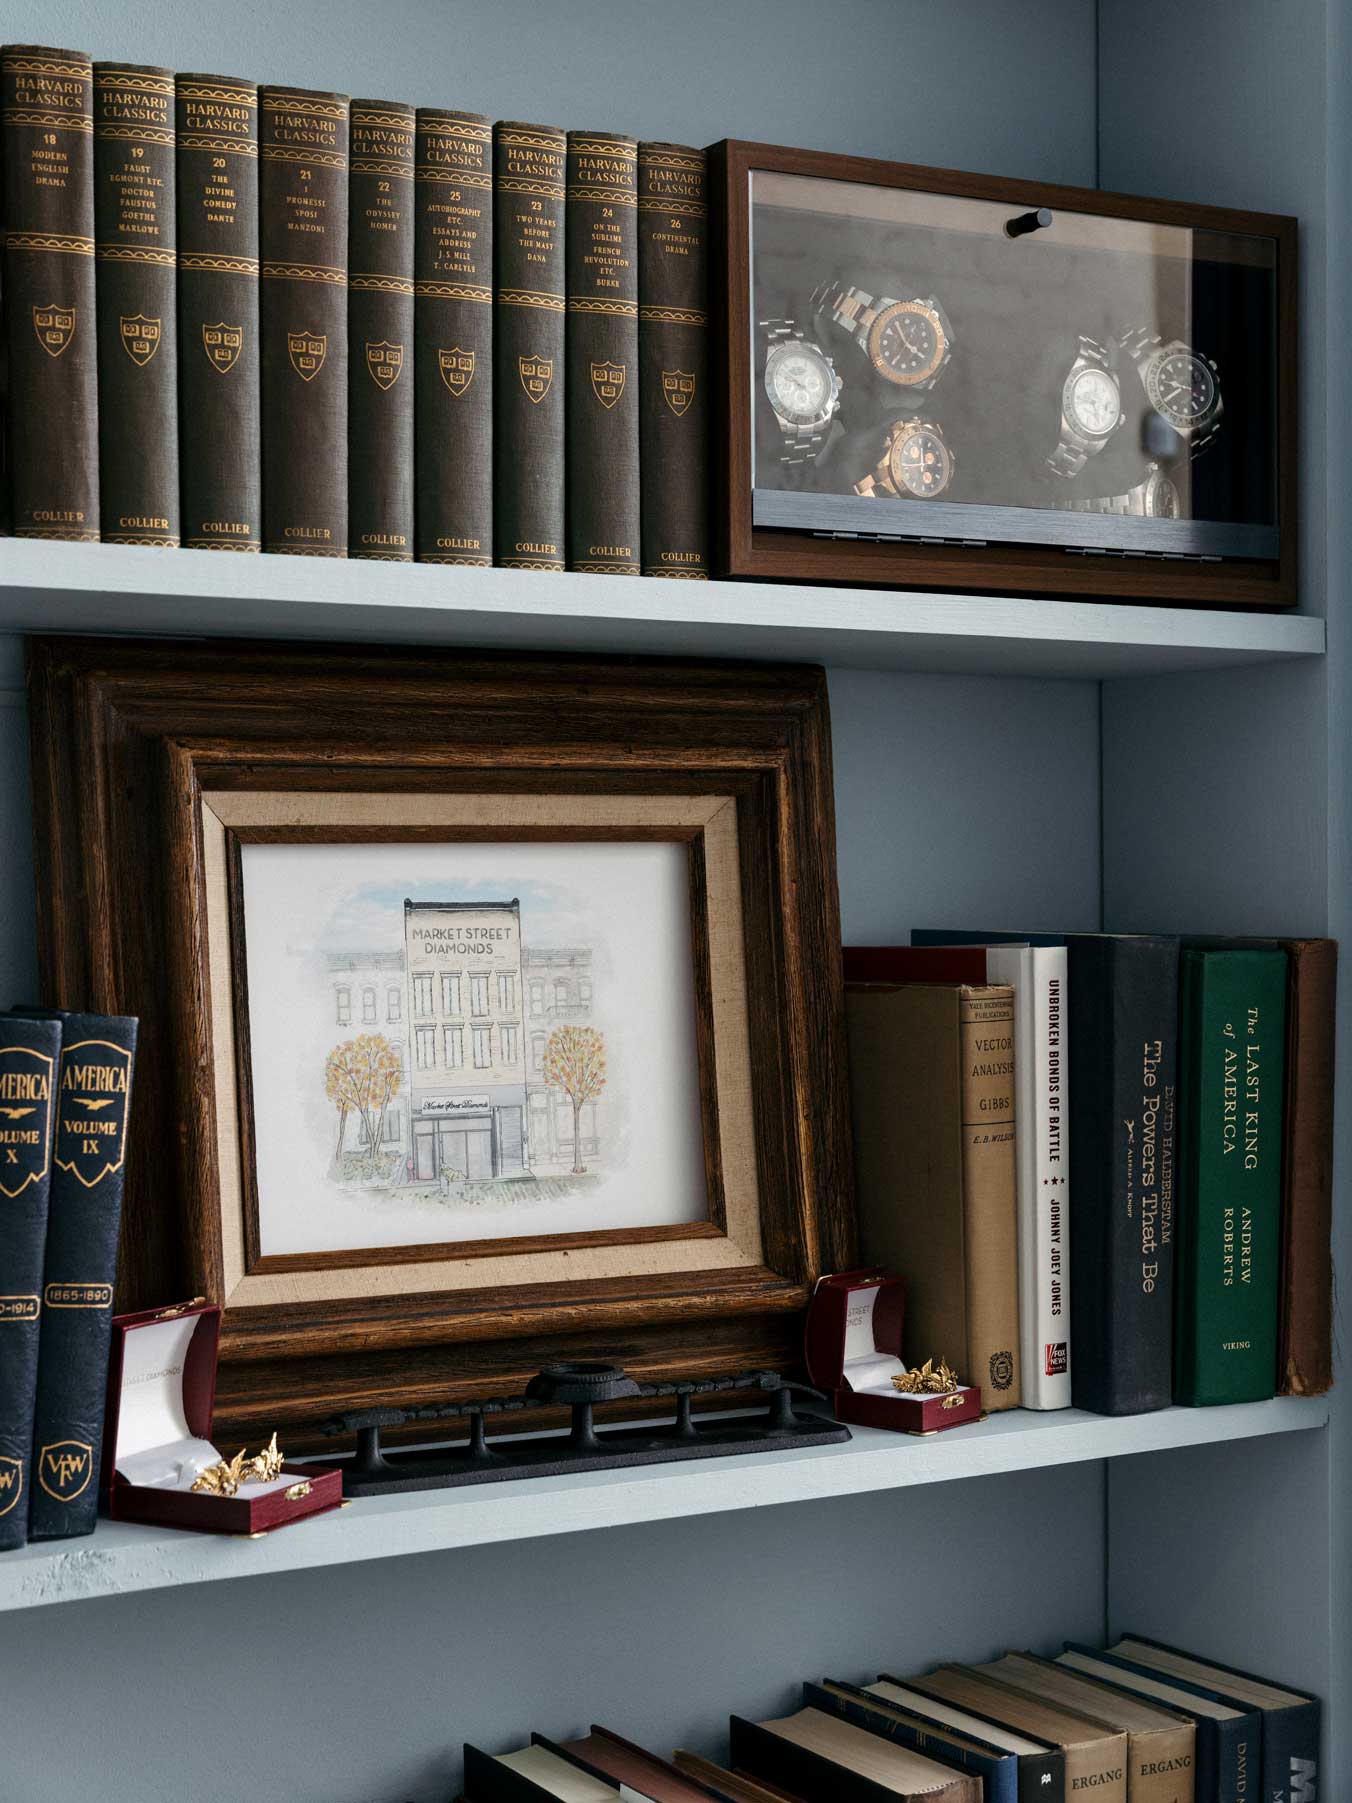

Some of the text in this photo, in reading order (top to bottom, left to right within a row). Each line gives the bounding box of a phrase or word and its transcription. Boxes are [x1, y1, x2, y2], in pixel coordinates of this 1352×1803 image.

[16, 78, 82, 94] HARVARD
[16, 92, 82, 107] CLASSICS
[104, 92, 167, 109] HARVARD
[104, 106, 167, 122] CLASSICS
[186, 104, 248, 120] HARVARD
[186, 117, 248, 133] CLASSICS
[275, 116, 336, 132] HARVARD
[44, 134, 56, 144] 18
[275, 129, 336, 145] CLASSICS
[353, 130, 413, 145] HARVARD
[131, 147, 144, 157] 19
[353, 142, 412, 158] CLASSICS
[428, 137, 482, 155] HARVARD
[32, 150, 67, 160] MODERN
[427, 151, 482, 167] CLASSICS
[508, 149, 563, 165] HARVARD
[32, 163, 68, 174] ENGLISH
[124, 164, 151, 173] FAUST
[212, 158, 226, 168] 20
[580, 158, 633, 172] HARVARD
[300, 170, 311, 180] 21
[508, 162, 563, 178] CLASSICS
[36, 176, 66, 186] DRAMA
[212, 176, 228, 184] THE
[579, 170, 632, 185] CLASSICS
[649, 170, 701, 184] HARVARD
[122, 188, 154, 198] DOCTOR
[206, 187, 235, 197] DIVINE
[378, 182, 390, 192] 22
[649, 182, 703, 196] CLASSICS
[450, 191, 461, 200] 25
[120, 199, 156, 208] FAUSTUS
[204, 200, 236, 209] COMEDY
[287, 196, 326, 208] PROMESSI
[377, 198, 392, 206] THE
[531, 201, 542, 211] 23
[122, 211, 155, 221] GOETHE
[295, 210, 318, 218] SPOSI
[366, 210, 400, 219] ODYSSEY
[427, 204, 481, 217] AUTOBIOGRAPHY
[603, 208, 614, 217] 24
[208, 214, 235, 223] DANTE
[516, 215, 556, 227] TWO YEARS
[671, 219, 681, 228] 26
[119, 224, 160, 234] MARLOWE
[288, 222, 325, 233] MANZONI
[370, 222, 397, 231] HOMER
[607, 224, 621, 232] THE
[433, 228, 476, 239] ESSAYS AND
[524, 228, 550, 238] BEFORE
[592, 233, 622, 243] SUBLIME
[652, 233, 699, 245] CONTINENTAL
[439, 239, 471, 248] ADDRESS
[520, 239, 554, 250] THE MAST
[454, 251, 470, 260] MILL
[593, 246, 621, 255] FRENCH
[665, 245, 688, 255] DRAMA
[528, 254, 546, 262] DANA
[584, 256, 628, 267] REVOLUTION
[444, 263, 476, 272] CARLYLE
[597, 279, 620, 288] BURKE
[33, 511, 84, 522] COLLIER
[120, 518, 168, 529] COLLIER
[202, 522, 250, 534] COLLIER
[284, 527, 330, 539] COLLIER
[362, 534, 406, 546] COLLIER
[437, 537, 480, 549] COLLIER
[516, 542, 556, 555] COLLIER
[590, 546, 631, 557] COLLIER
[661, 552, 700, 562] COLLIER
[412, 928, 512, 940] MARKET STREET
[425, 943, 493, 954] DIAMONDS
[975, 1038, 1012, 1051] VECTOR
[972, 1062, 1015, 1077] ANALYSIS
[1049, 979, 1060, 1163] UNBROKEN BONDS OF BATTLE
[62, 1065, 126, 1093] AMERICA
[1224, 1023, 1237, 1154] of AMERICA
[1245, 1007, 1259, 1169] The LAST KING
[980, 1097, 1010, 1111] GIBBS
[64, 1120, 117, 1135] VOLUME
[82, 1140, 99, 1154] IX
[6, 1148, 18, 1163] X
[1142, 1041, 1162, 1293] The Powers That Be
[1162, 1086, 1174, 1244] DAVID HALBERSTAM
[1224, 1208, 1234, 1286] ROBERTS
[1242, 1207, 1251, 1284] ANDREW
[1051, 1199, 1061, 1316] JOHNNY JOEY JONES
[50, 1289, 108, 1301] 1865-1890
[1223, 1341, 1250, 1350] VIKING
[1052, 1357, 1066, 1365] NEWS
[1141, 1756, 1191, 1776] ERGANG
[1237, 1743, 1247, 1792] DAVID
[1072, 1769, 1122, 1790] ERGANG
